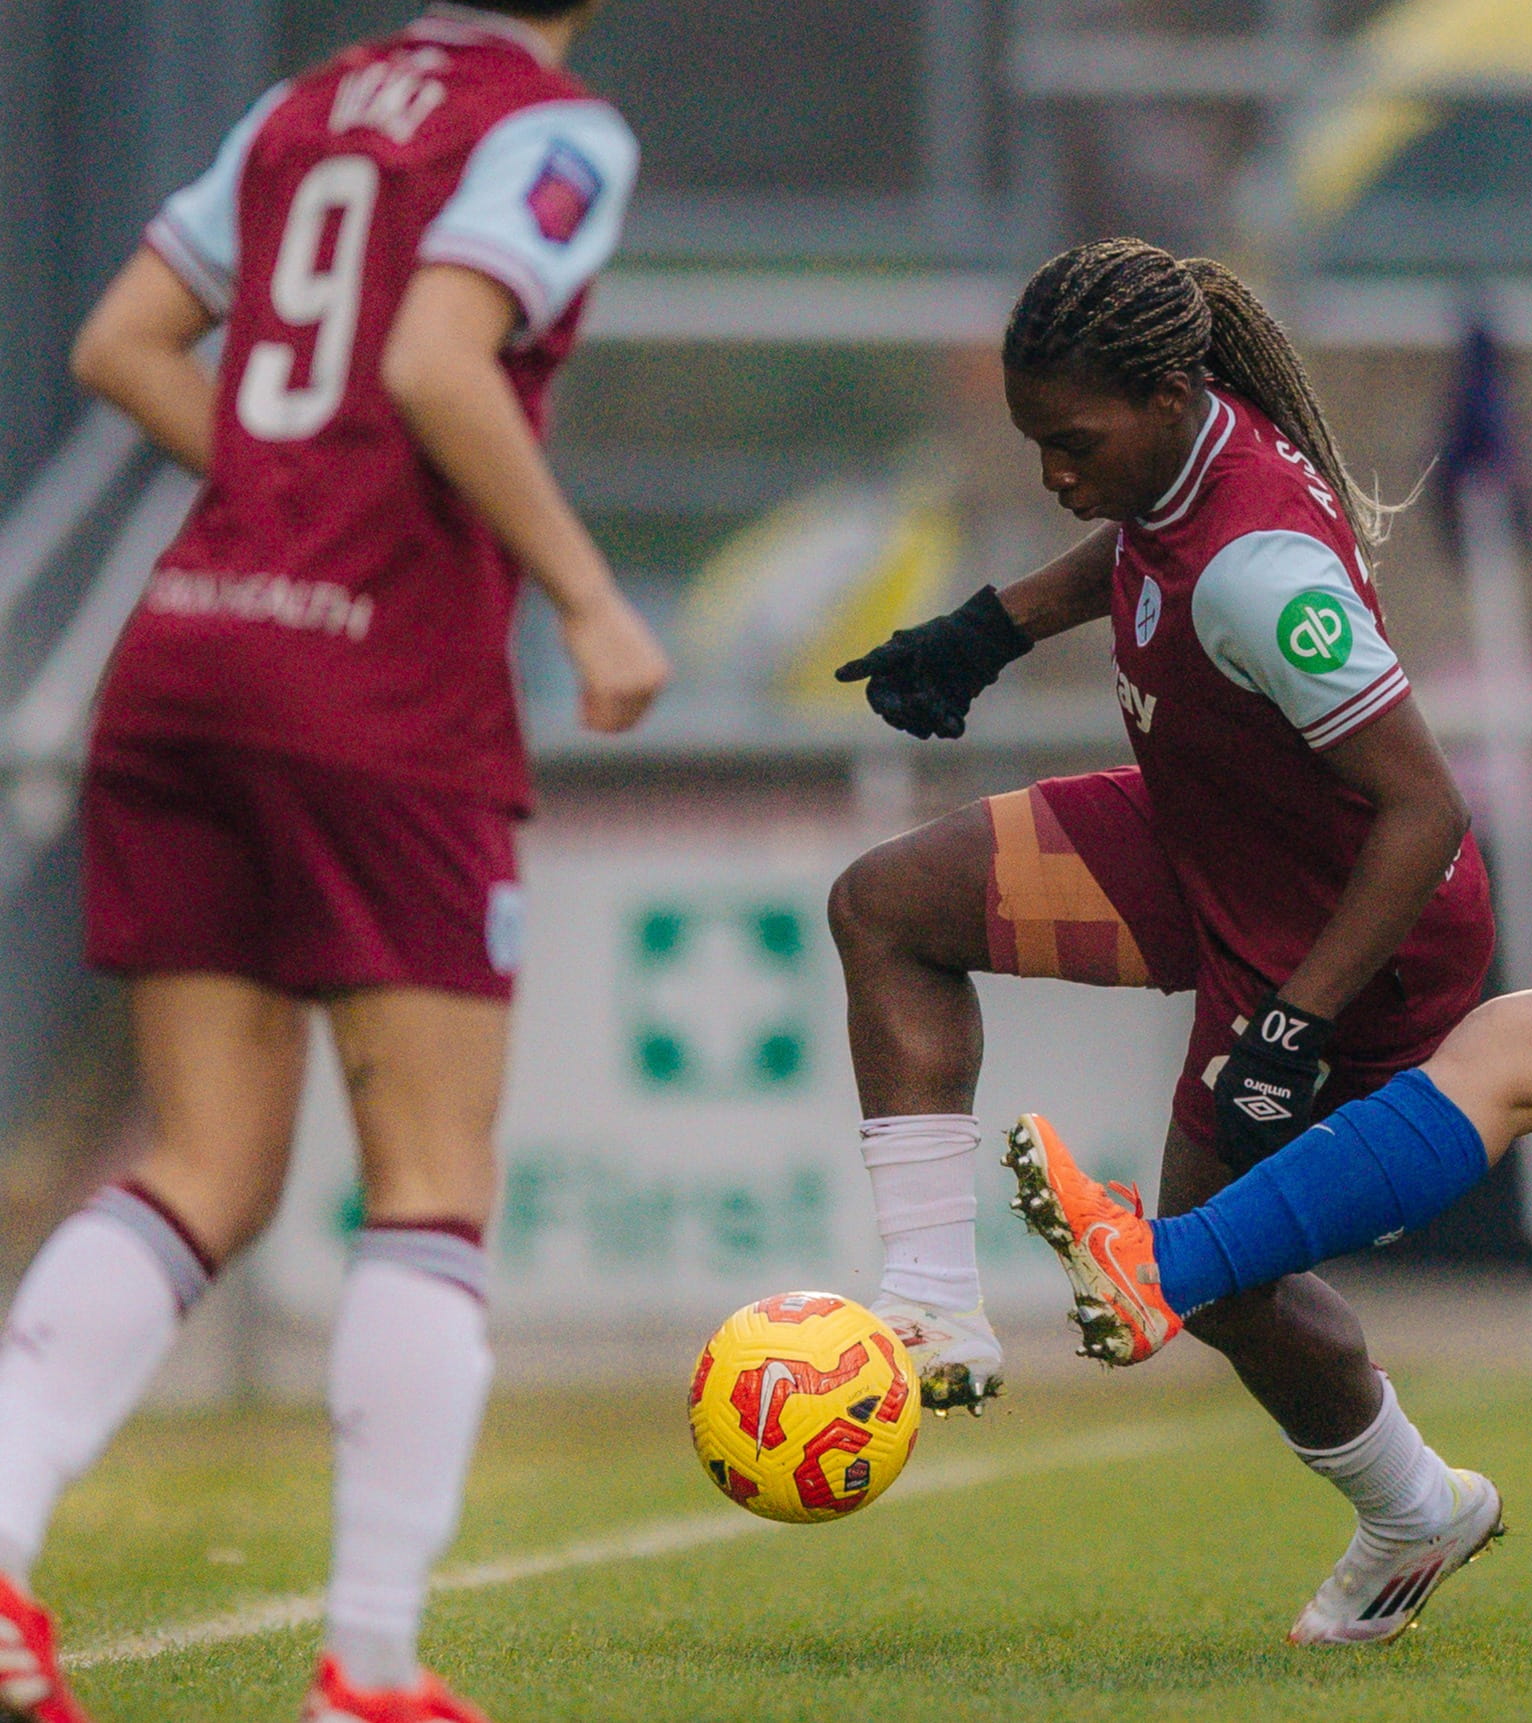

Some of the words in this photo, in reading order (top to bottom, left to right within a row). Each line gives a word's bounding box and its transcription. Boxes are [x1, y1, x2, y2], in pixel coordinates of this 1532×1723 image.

[236, 154, 380, 441] 9
[1261, 1009, 1310, 1052] 20
[1243, 1077, 1292, 1100] umbro
